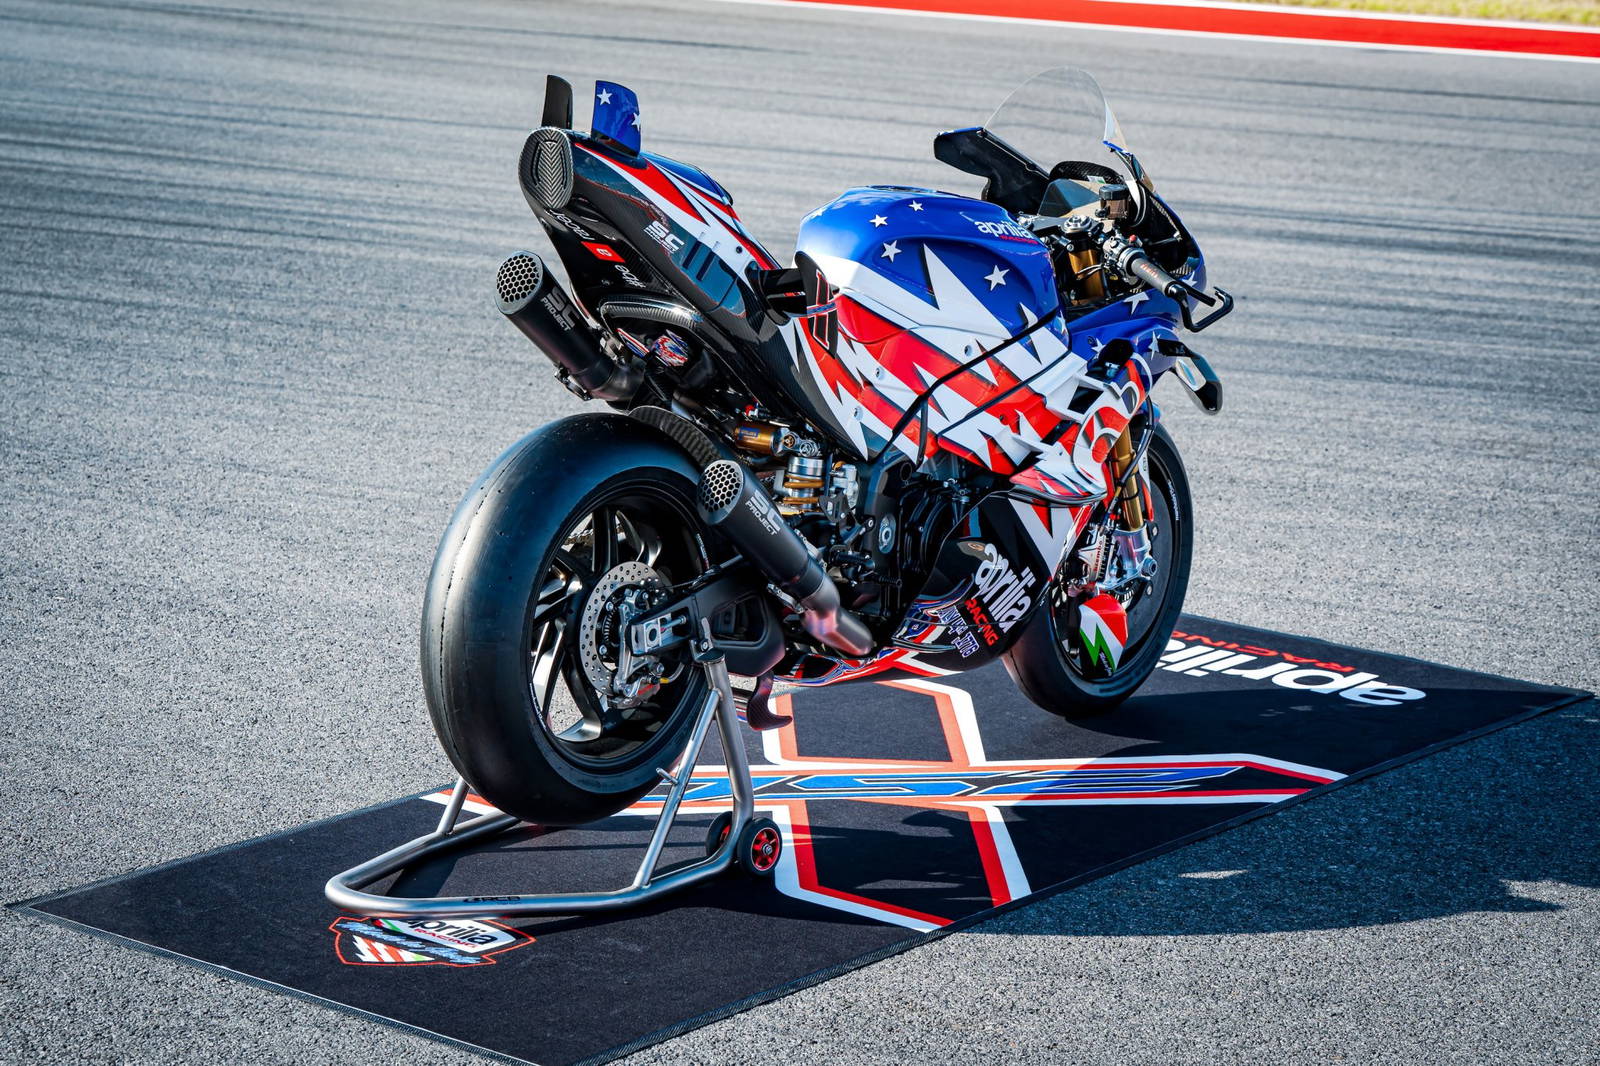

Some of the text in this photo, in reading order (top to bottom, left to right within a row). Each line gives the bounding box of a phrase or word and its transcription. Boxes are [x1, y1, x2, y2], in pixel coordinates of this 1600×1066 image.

[646, 220, 685, 251] SC
[974, 220, 1035, 239] aprilia
[540, 296, 572, 331] PROJECT
[547, 286, 580, 328] SC
[745, 500, 778, 536] PROJECT
[750, 490, 784, 532] SC
[971, 543, 1036, 634] aprilia
[964, 598, 1000, 647] RACING
[408, 921, 498, 945] prilia
[415, 928, 480, 948] RACING
